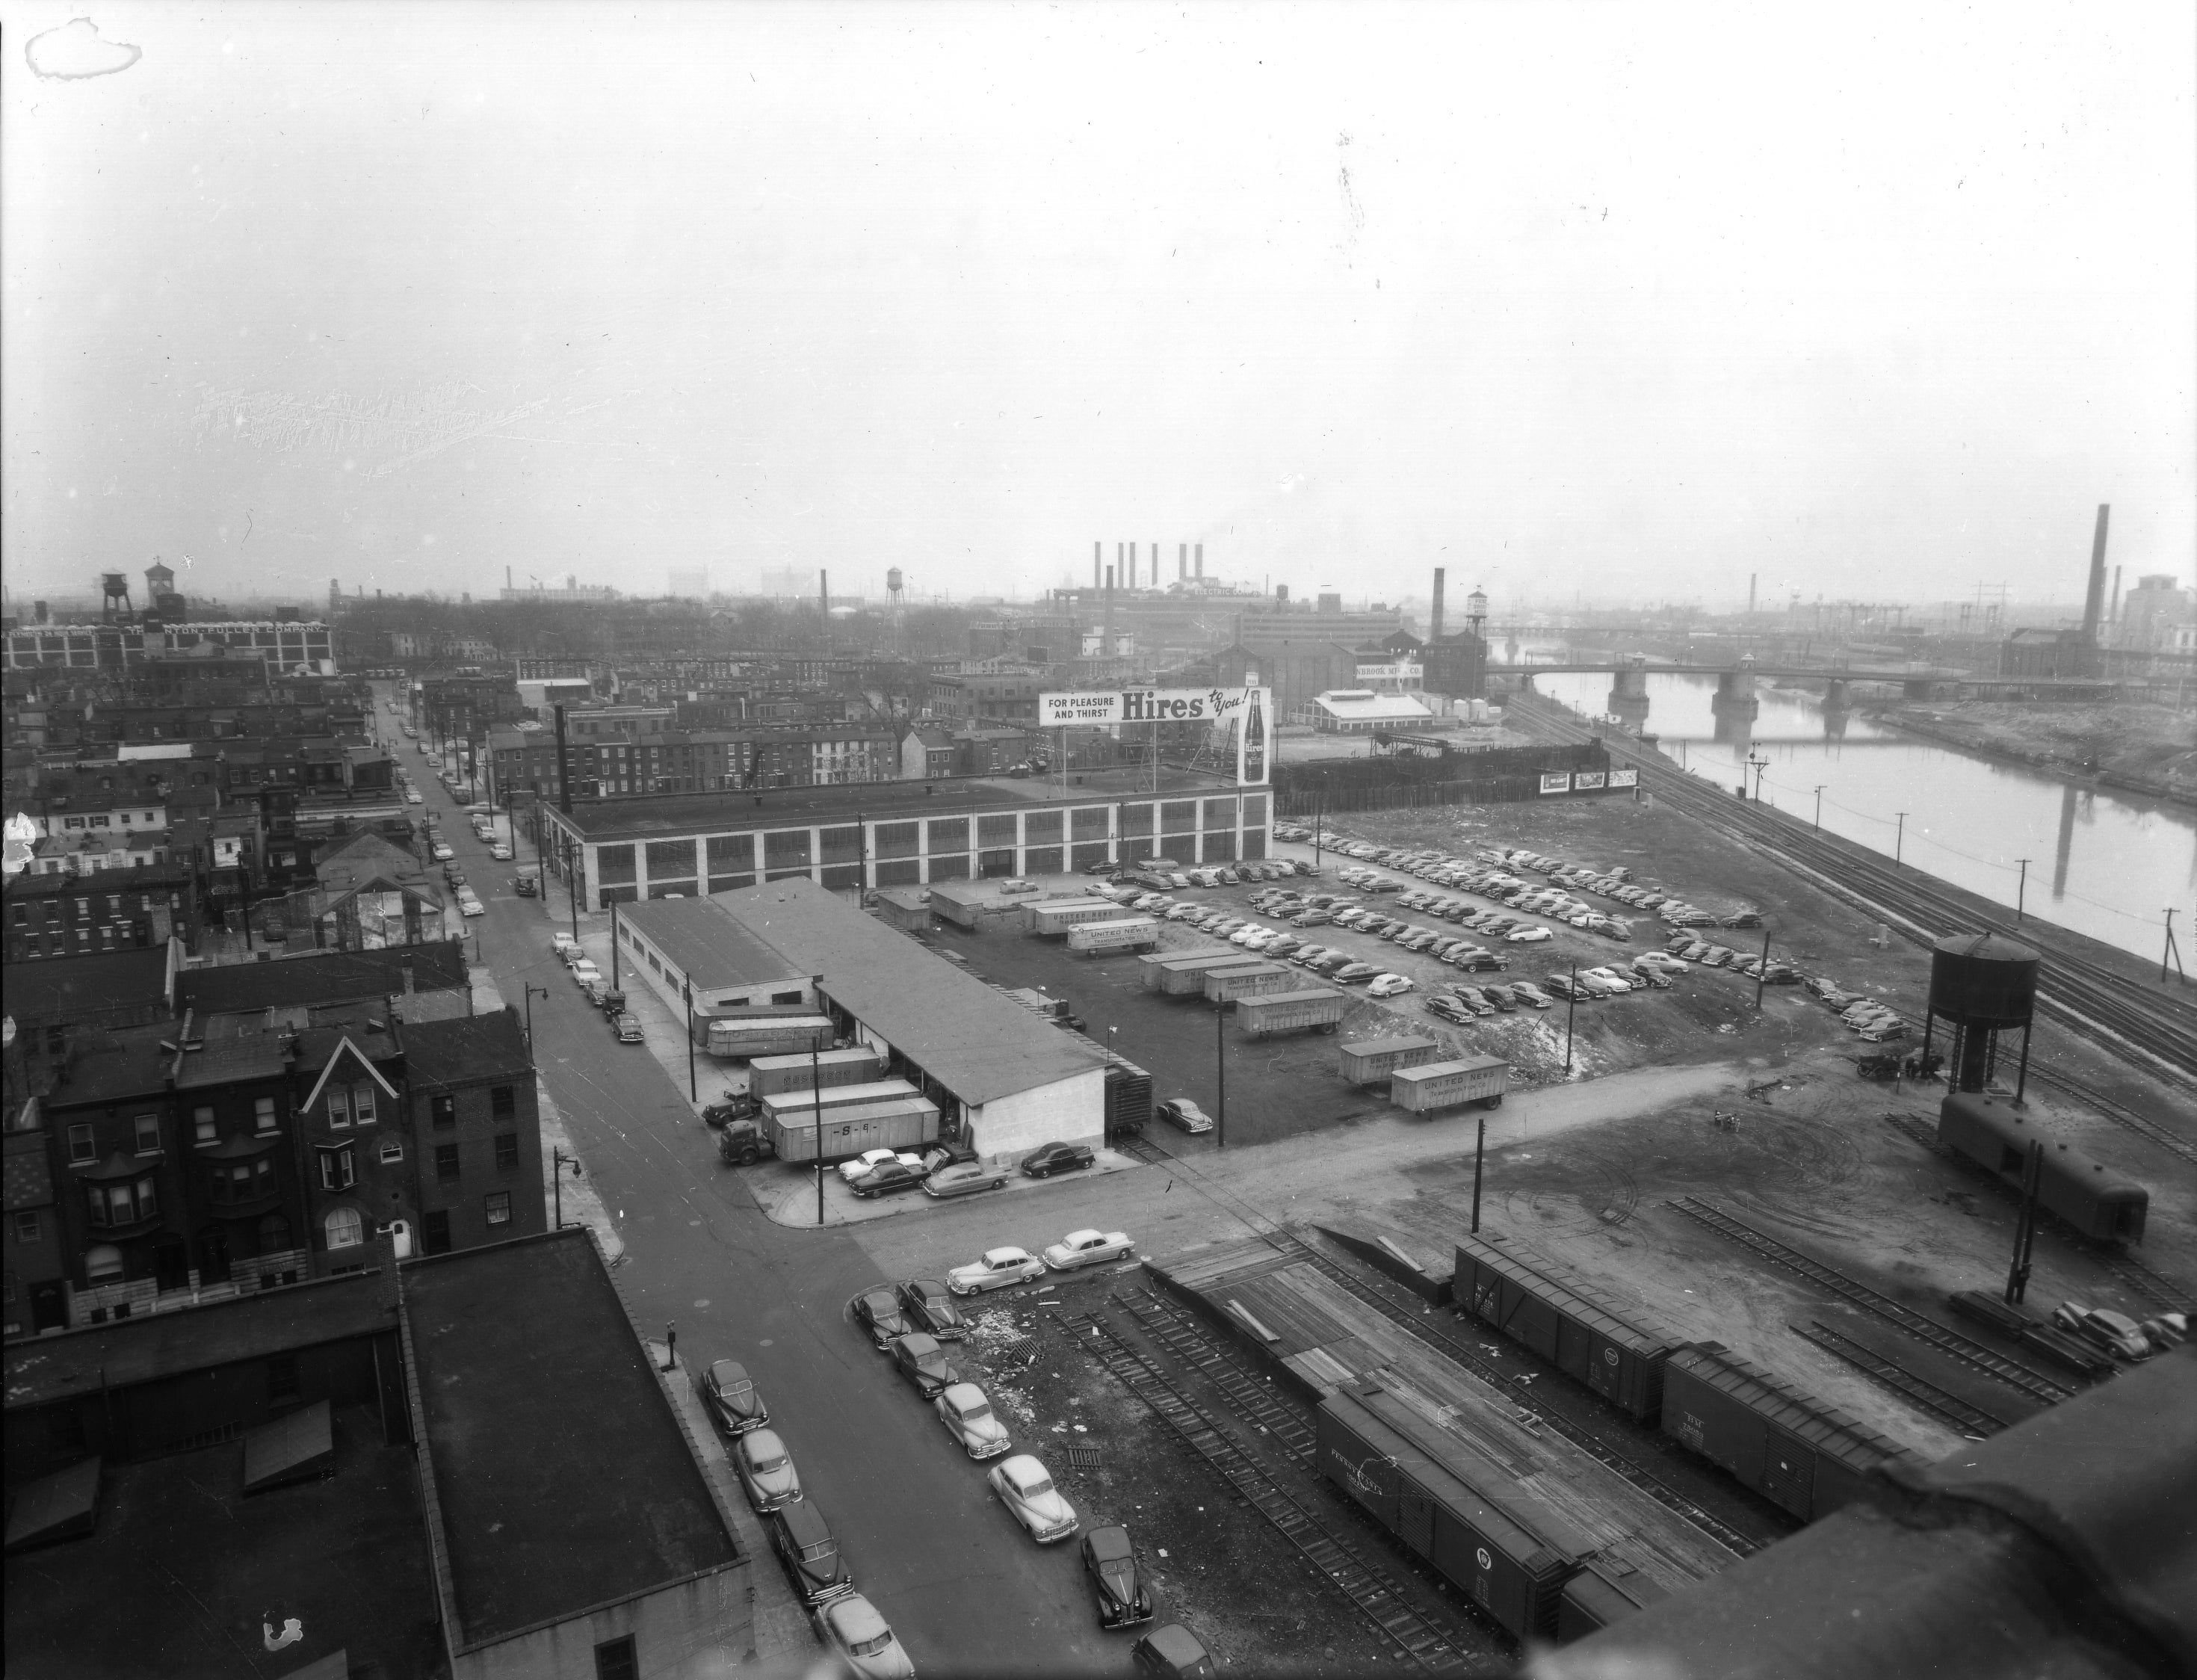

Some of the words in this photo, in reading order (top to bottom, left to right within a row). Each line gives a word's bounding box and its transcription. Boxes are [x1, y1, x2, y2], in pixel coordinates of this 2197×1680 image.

[130, 626, 259, 634] THNTON-FULLER
[1208, 688, 1223, 703] to
[1048, 698, 1068, 708] FOR
[1070, 697, 1114, 707] PLEASURE
[1121, 691, 1203, 720] Hires
[1054, 709, 1073, 719] AND
[1076, 708, 1108, 718] THIRST
[1091, 930, 1121, 938] UNITED
[1093, 936, 1136, 944] TRANSPORTATION
[1227, 983, 1268, 991] TRANSPORTATION
[1228, 978, 1256, 986] UNITED
[1260, 1004, 1297, 1015] UNITED
[1304, 1000, 1329, 1009] NEWS
[1371, 1054, 1399, 1064] UNITED
[1403, 1051, 1428, 1060] NEWS
[1424, 1077, 1463, 1090] UNITED
[1470, 1071, 1495, 1081] NEWS
[1431, 1084, 1476, 1097] TRANSPORTATION
